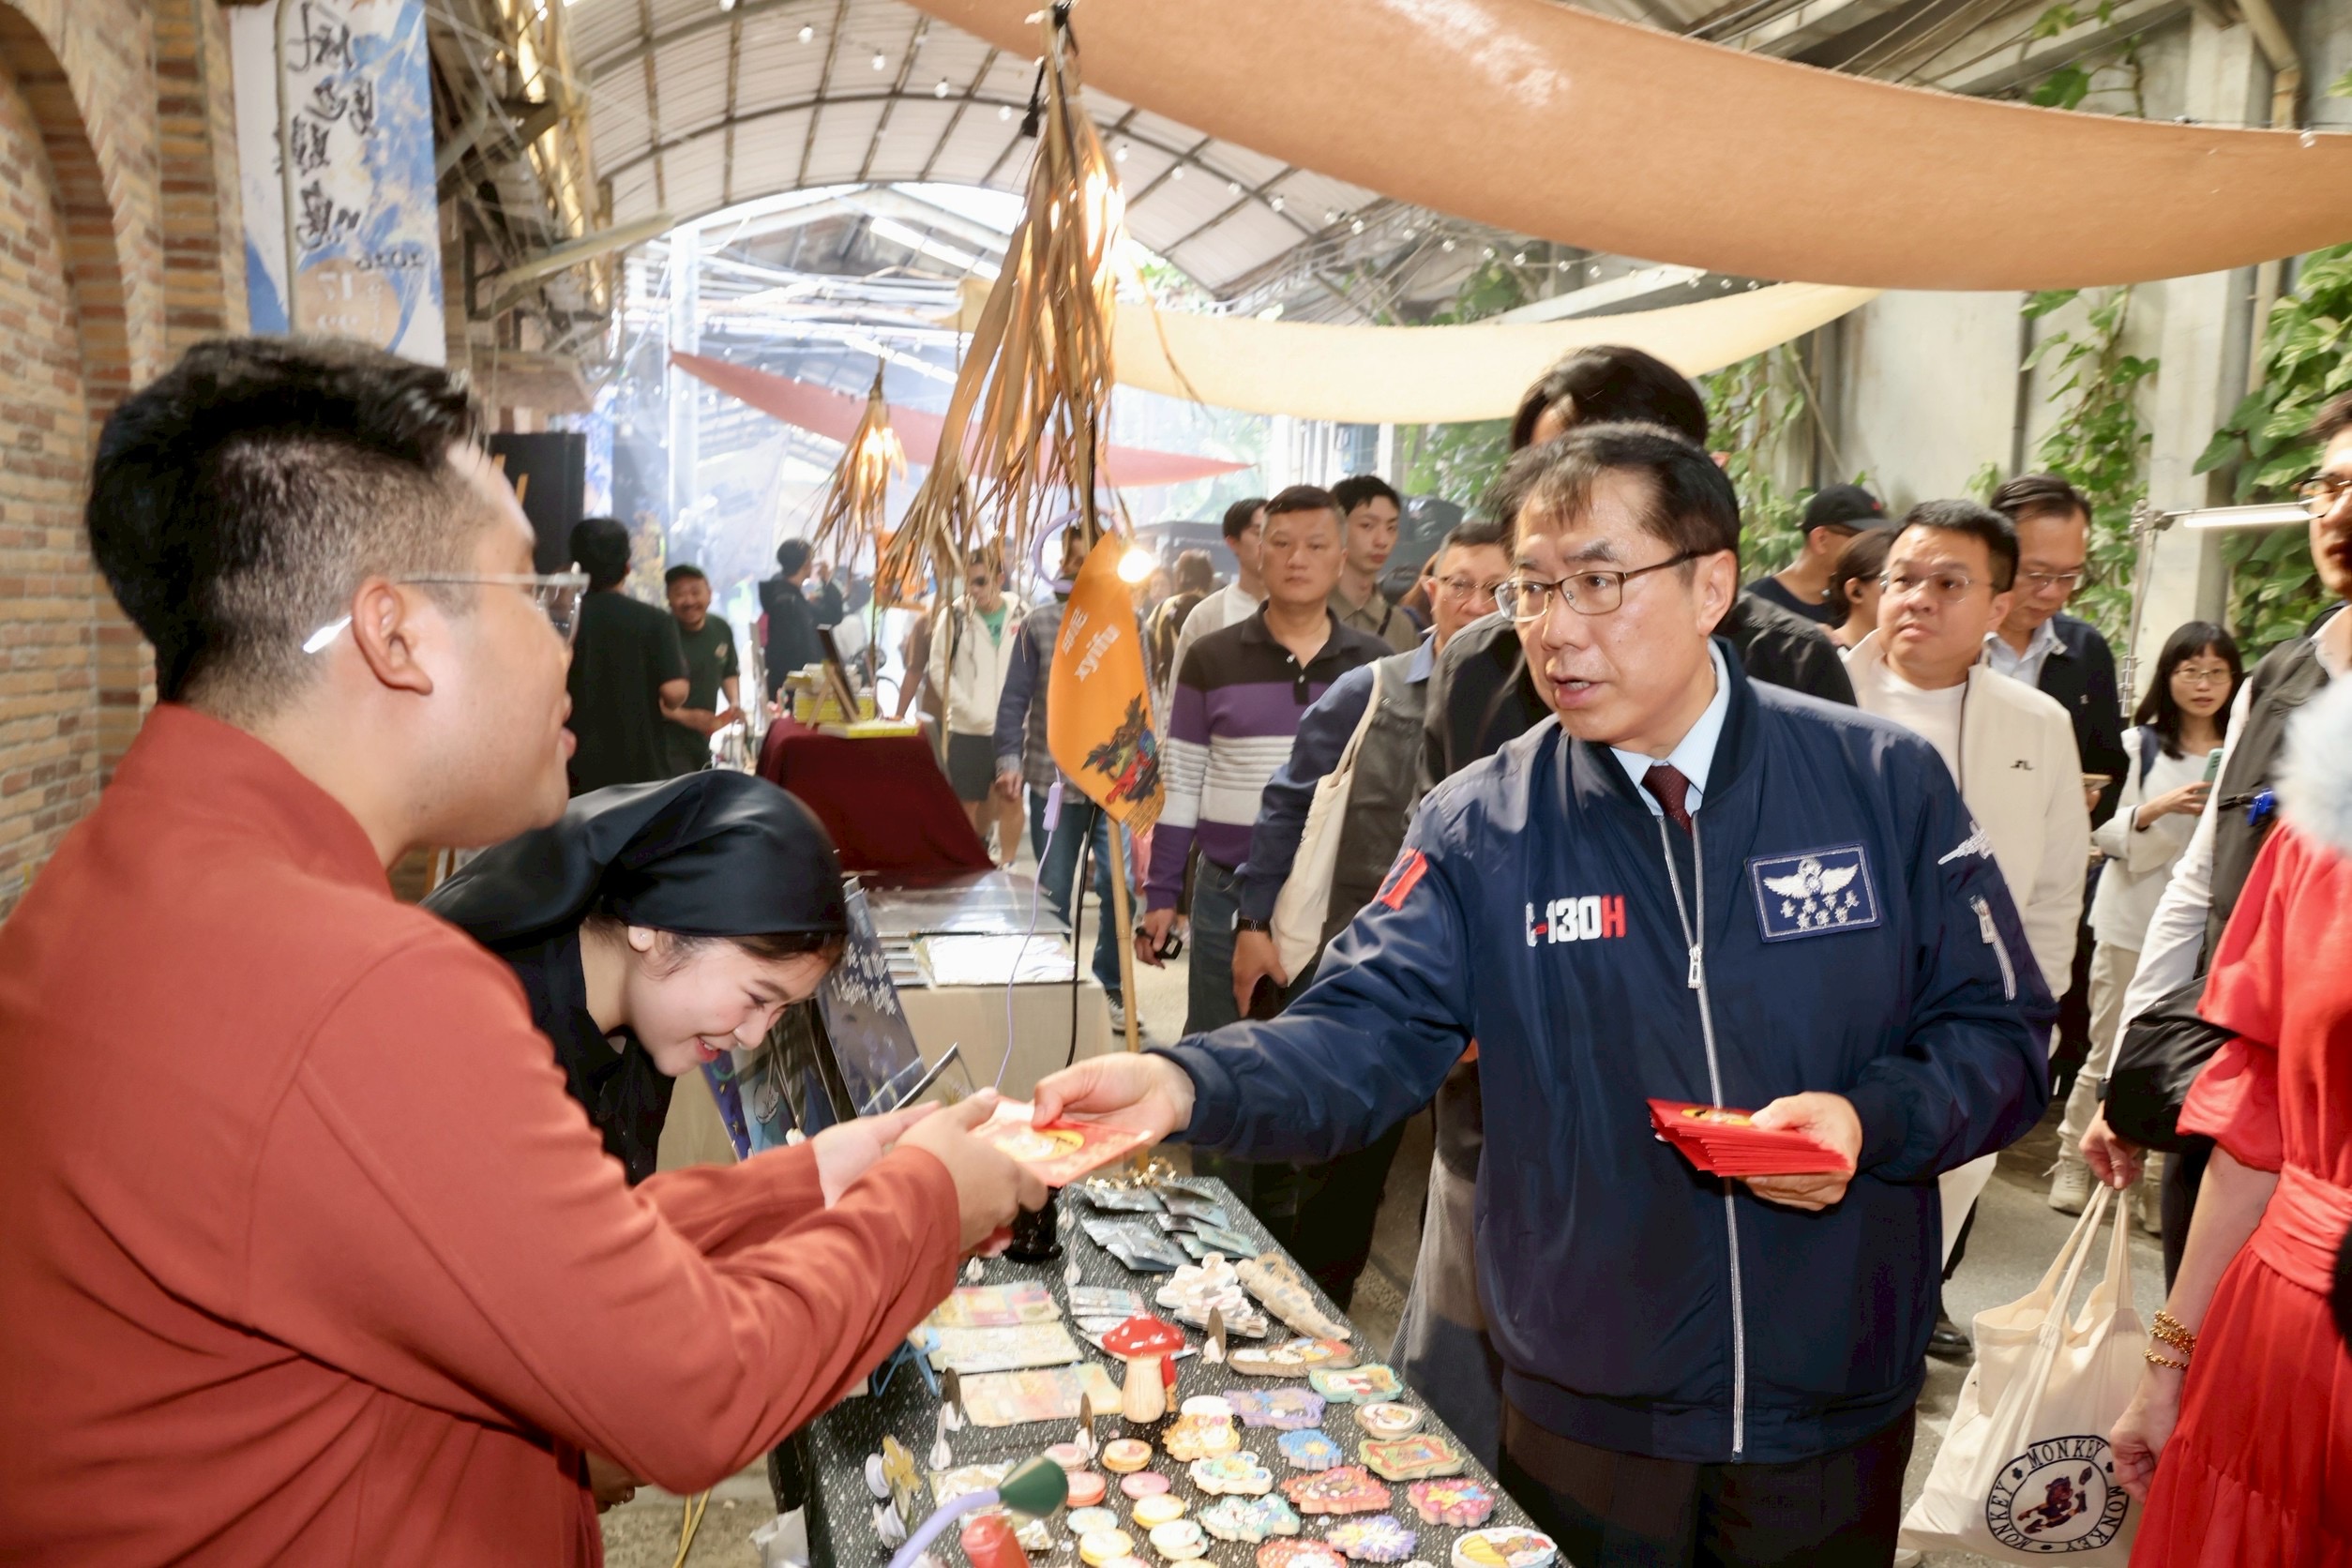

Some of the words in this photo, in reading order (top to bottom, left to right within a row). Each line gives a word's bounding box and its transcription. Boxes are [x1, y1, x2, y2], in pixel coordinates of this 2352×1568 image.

[2027, 1439, 2105, 1470] MONKEY
[1989, 1479, 2033, 1548] MONKEY
[2066, 1485, 2127, 1553] MONKEY
